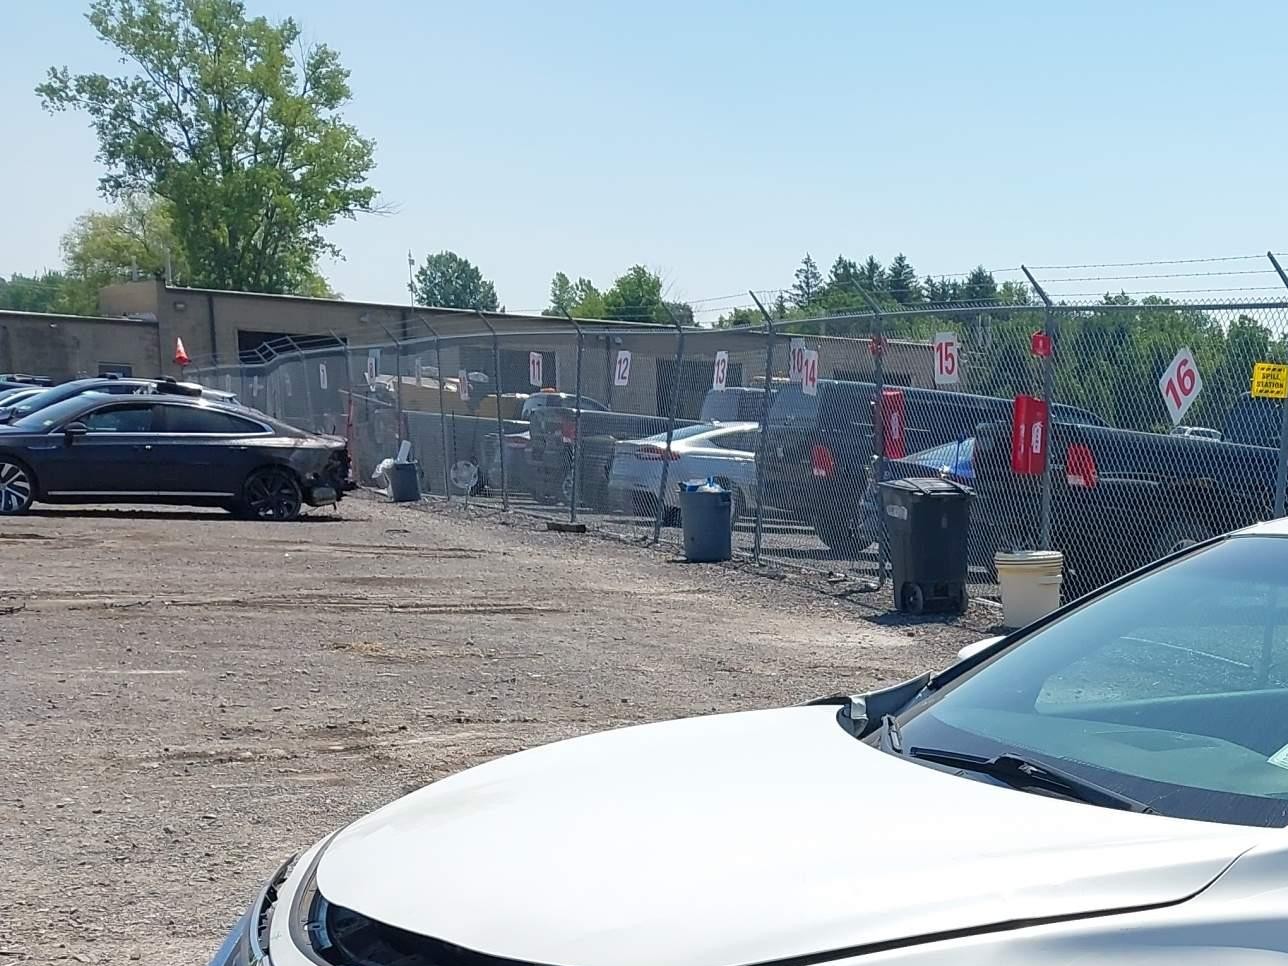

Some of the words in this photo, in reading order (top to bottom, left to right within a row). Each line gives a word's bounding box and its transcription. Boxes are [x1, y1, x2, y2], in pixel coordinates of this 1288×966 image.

[531, 359, 541, 380] 11
[616, 357, 629, 380] 12
[715, 358, 726, 384] 13
[936, 342, 955, 375] 15
[804, 358, 816, 387] 14
[1166, 358, 1196, 409] 16
[1256, 381, 1284, 389] STATION
